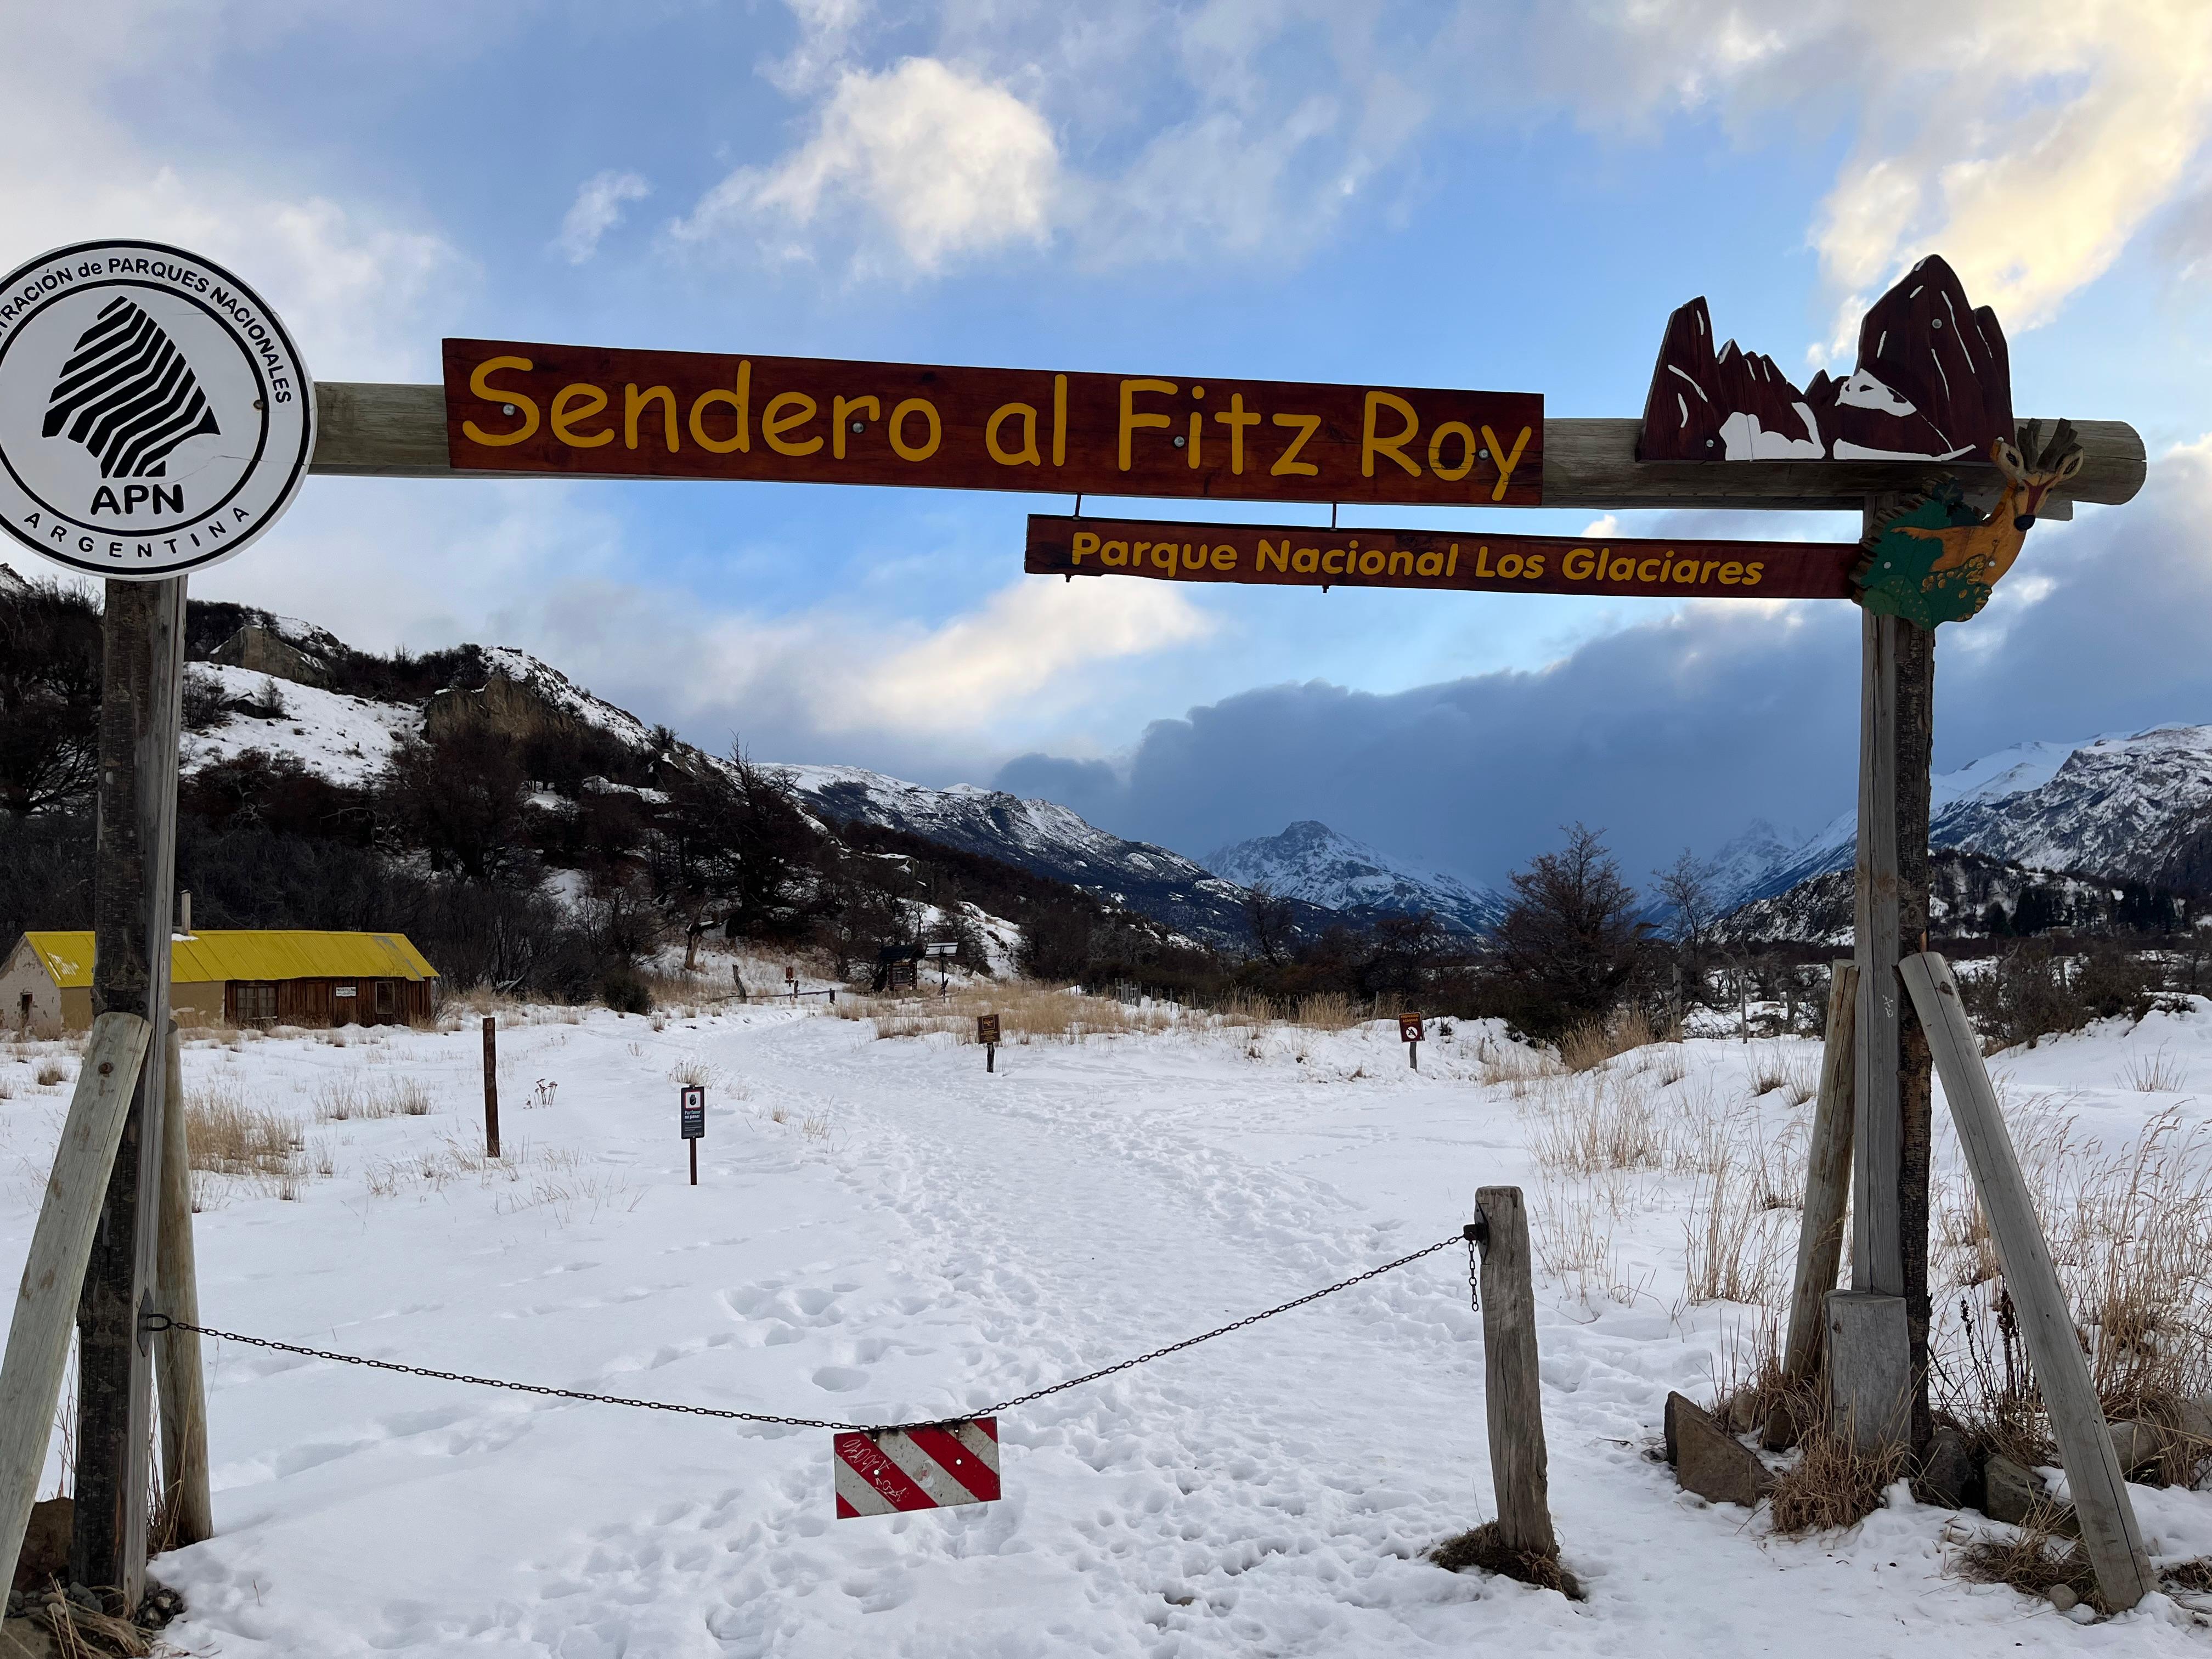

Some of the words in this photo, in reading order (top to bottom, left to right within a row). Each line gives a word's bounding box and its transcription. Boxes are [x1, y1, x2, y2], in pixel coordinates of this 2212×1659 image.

[77, 262, 103, 278] de
[108, 258, 210, 293] PARQUES
[210, 286, 292, 404] NACIONALES
[462, 356, 941, 462] Sendero
[985, 374, 1068, 467] al
[1119, 379, 1321, 476] Fitz
[1362, 391, 1532, 501] Roy
[90, 483, 184, 515] APN
[24, 507, 250, 558] ARGENTINA
[1072, 532, 1238, 578] Parque
[1256, 539, 1458, 577] Nacional
[1475, 546, 1545, 579] Los
[1562, 548, 1764, 585] Glaciares
